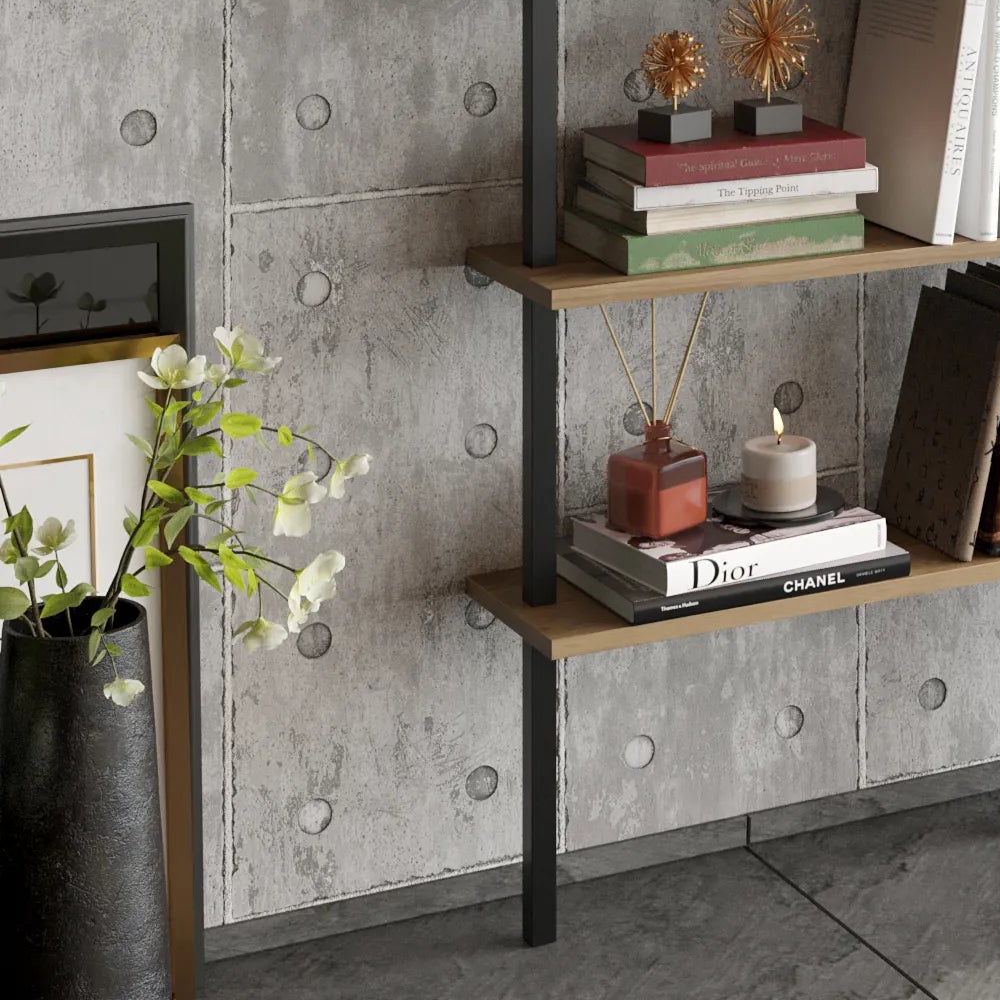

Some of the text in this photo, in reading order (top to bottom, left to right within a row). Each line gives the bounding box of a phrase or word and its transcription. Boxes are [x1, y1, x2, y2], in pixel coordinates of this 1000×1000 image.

[950, 47, 977, 176] ANTIQUAIRES
[717, 184, 800, 198] The Tipping Point
[688, 558, 759, 591] Dior
[783, 571, 846, 594] CHANEL
[660, 604, 678, 612] Thames
[682, 600, 699, 608] Hudson
